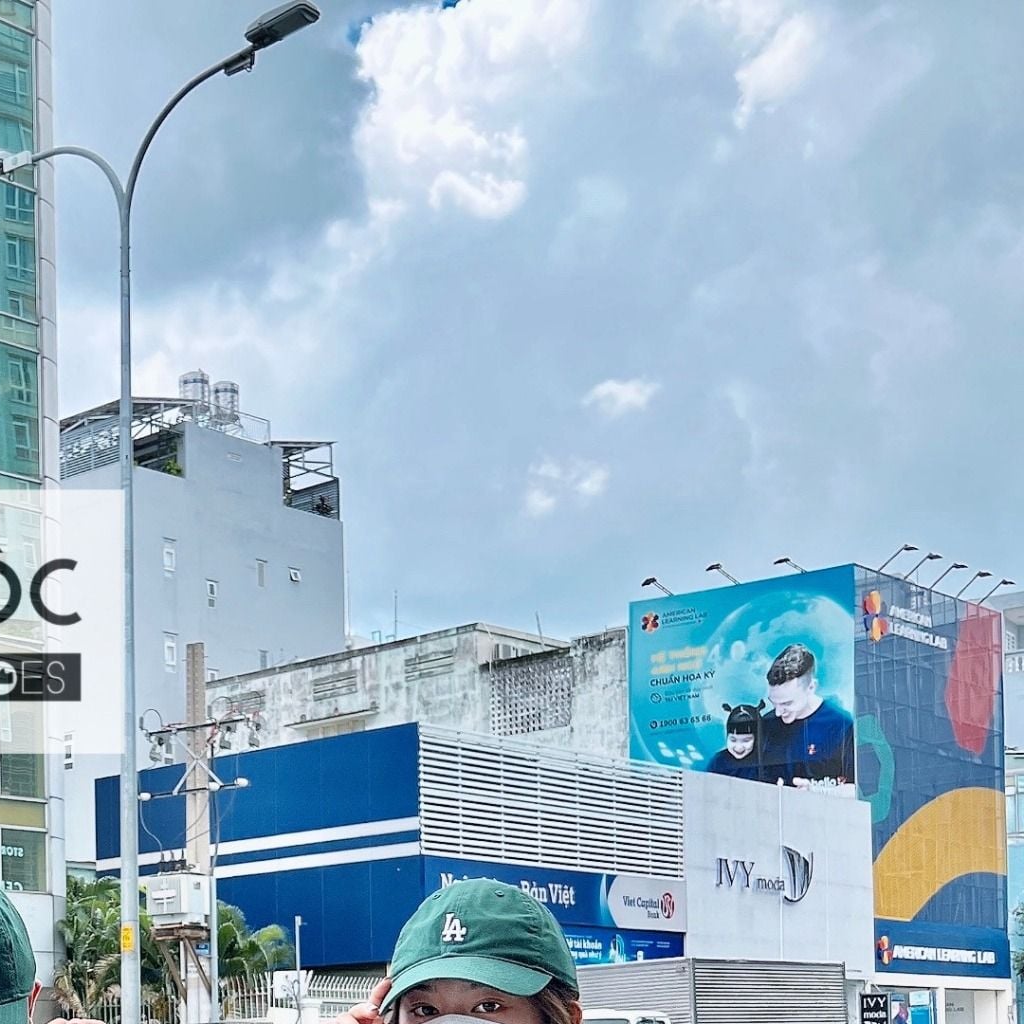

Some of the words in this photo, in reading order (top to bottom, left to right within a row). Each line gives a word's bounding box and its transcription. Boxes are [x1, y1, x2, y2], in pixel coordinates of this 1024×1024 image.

[682, 672, 701, 681] HOA
[716, 857, 755, 888] IVY
[756, 877, 785, 891] moda
[548, 882, 576, 909] Việt
[623, 895, 636, 907] Viet
[636, 896, 660, 910] Capital
[441, 913, 467, 942] LA
[863, 997, 886, 1009] IVY
[863, 1010, 887, 1019] moda
